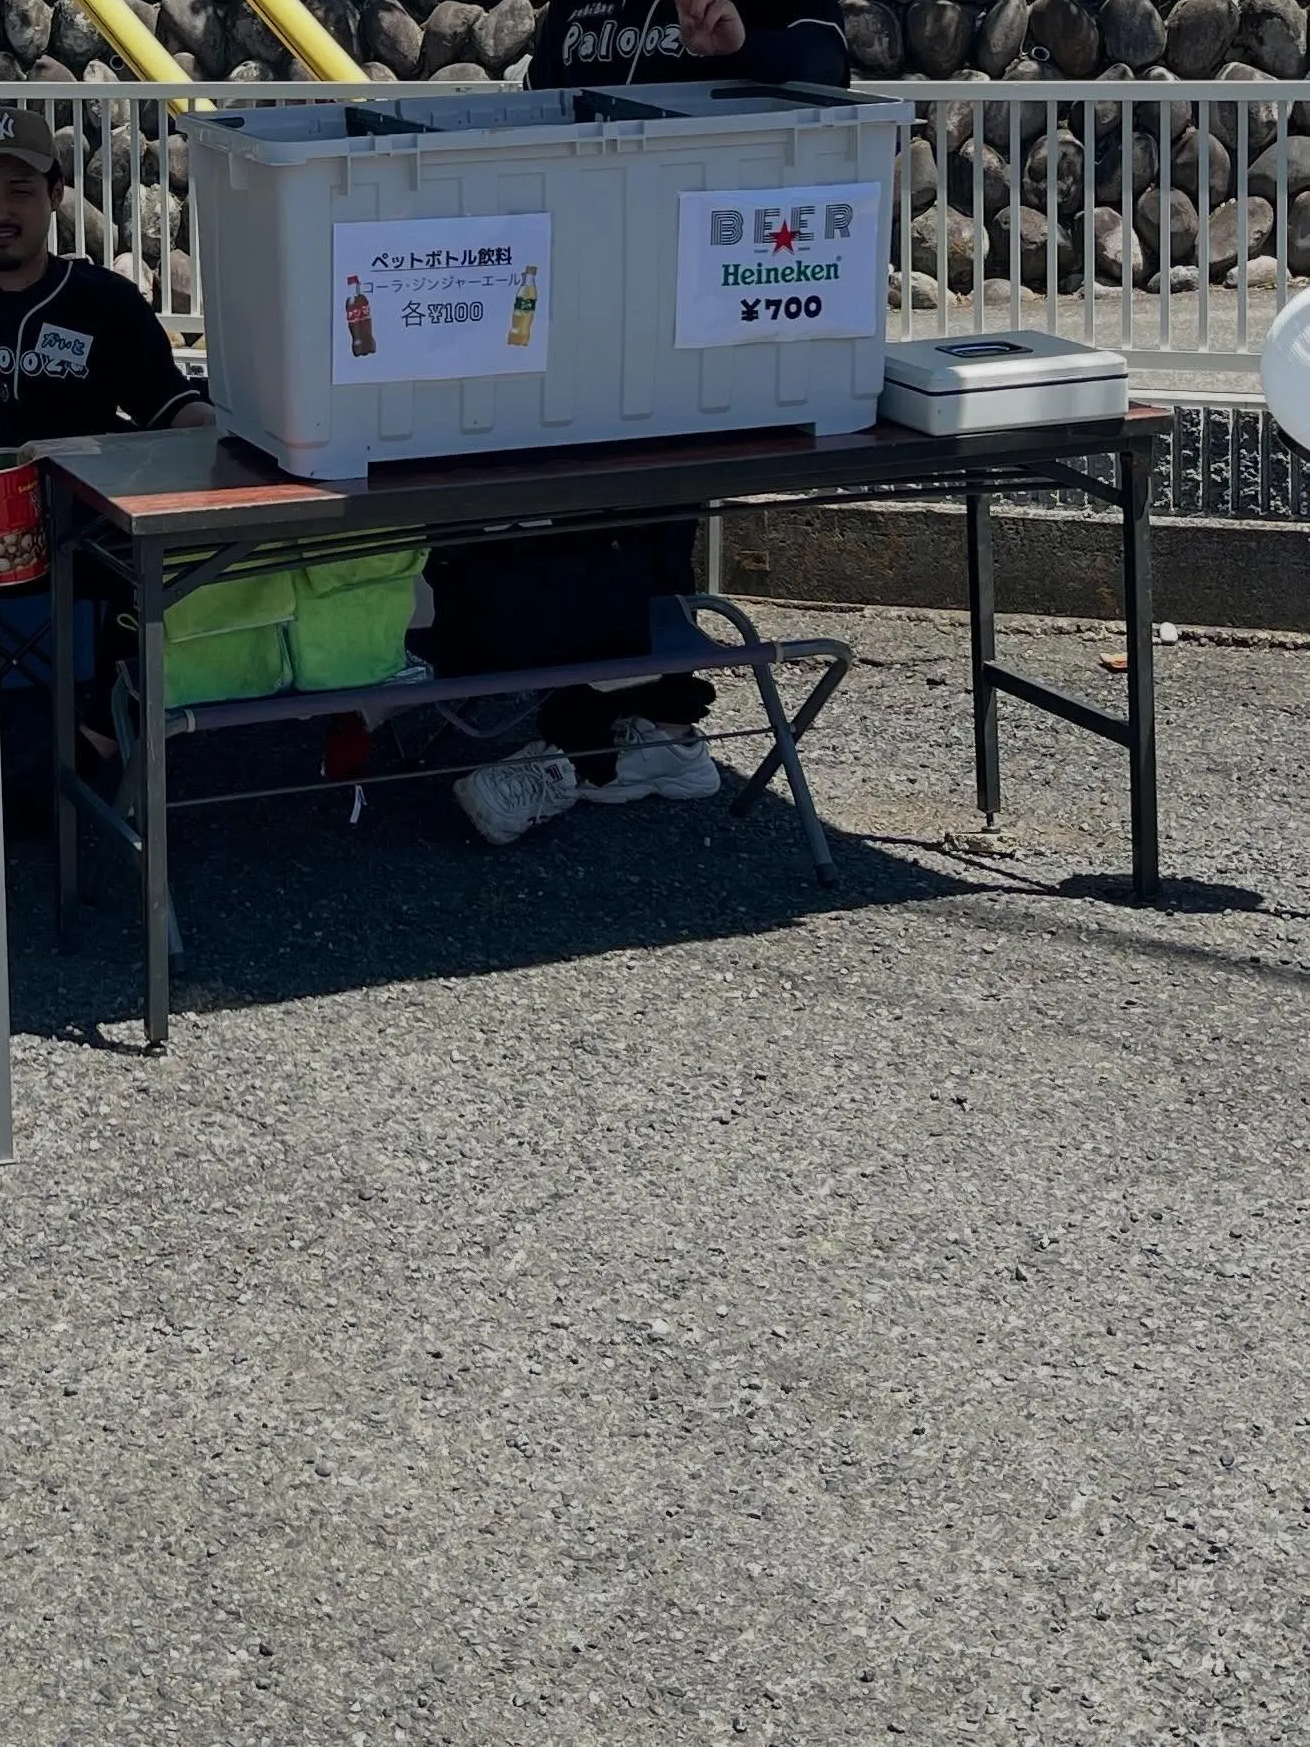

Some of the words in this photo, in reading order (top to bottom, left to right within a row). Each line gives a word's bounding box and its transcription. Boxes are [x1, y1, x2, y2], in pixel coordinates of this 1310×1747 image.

[562, 20, 702, 66] Palooz
[710, 203, 854, 246] BEER
[371, 246, 513, 269] ペットボトル飲料
[740, 294, 823, 322] ¥700
